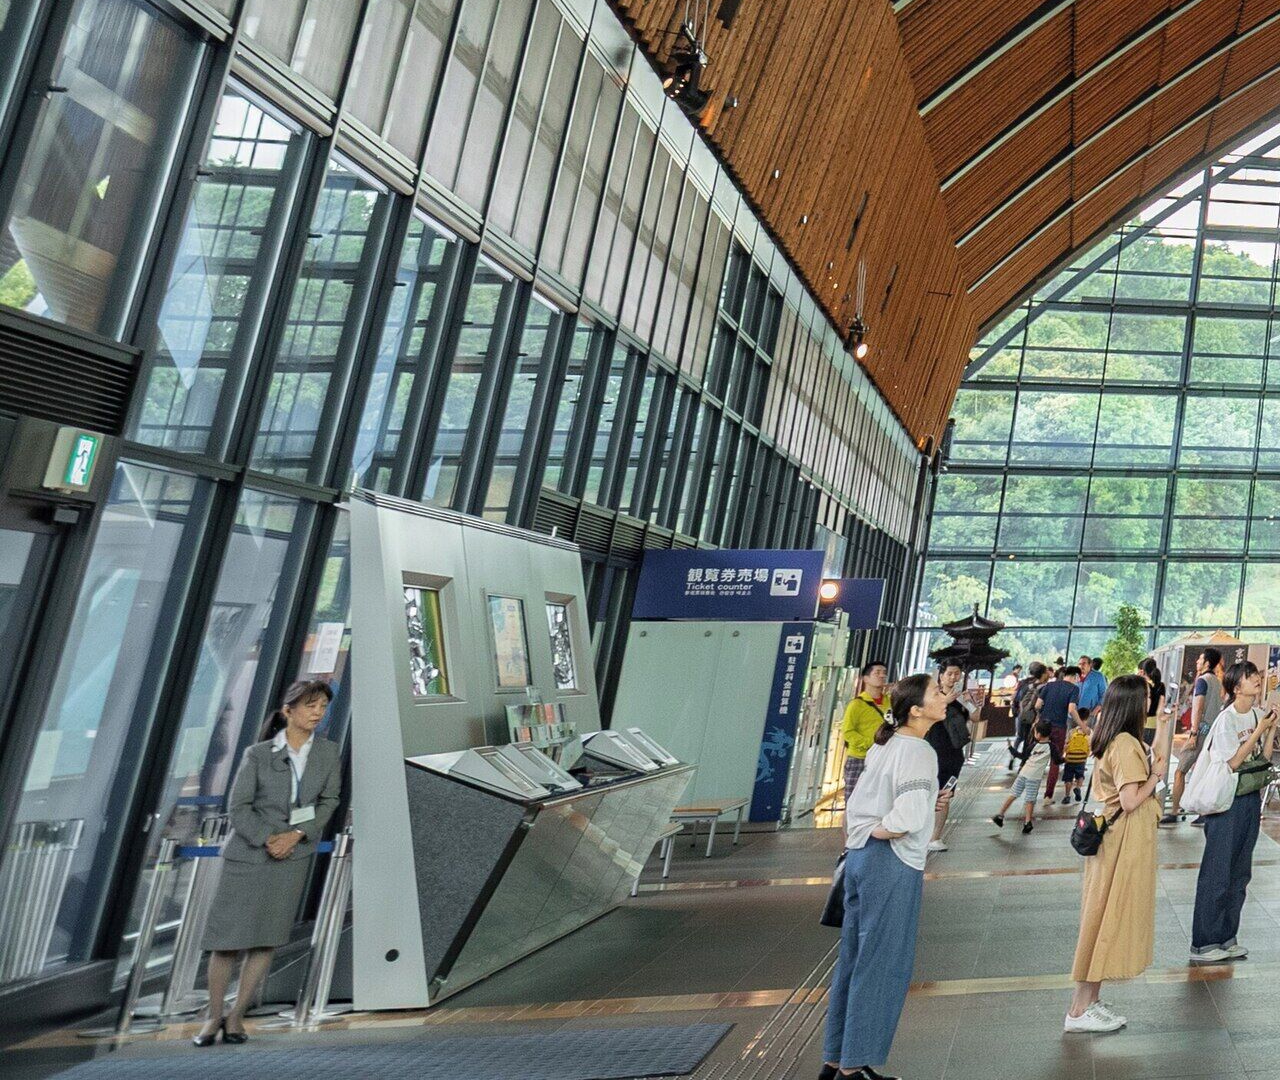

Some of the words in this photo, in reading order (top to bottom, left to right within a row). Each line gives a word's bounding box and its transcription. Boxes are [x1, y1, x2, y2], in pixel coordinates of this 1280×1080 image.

[687, 568, 769, 583] 観覧券売場
[686, 582, 715, 591] Ticket
[717, 582, 754, 591] counter
